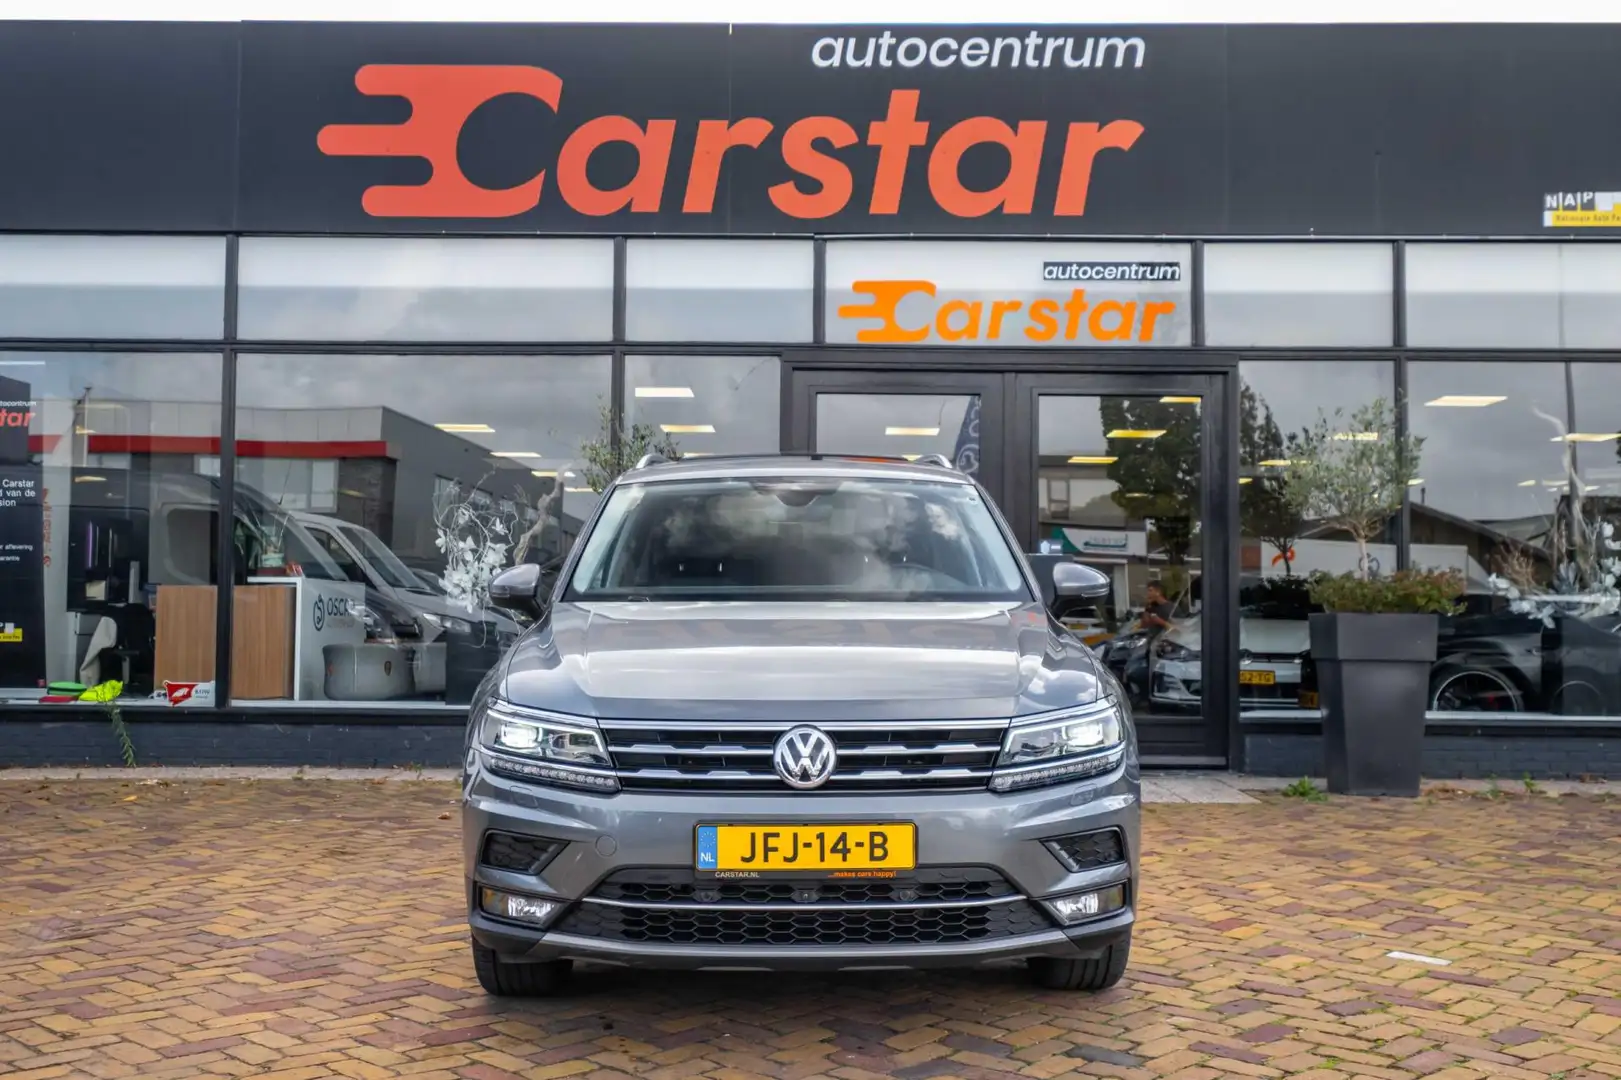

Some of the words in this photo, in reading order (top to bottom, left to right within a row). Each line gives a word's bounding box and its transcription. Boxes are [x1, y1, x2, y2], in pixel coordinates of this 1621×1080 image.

[811, 30, 1146, 68] autocentrum
[316, 63, 1145, 219] Carstar
[1043, 263, 1181, 280] autocentrum
[837, 279, 1176, 343] Carstar
[2, 479, 35, 488] Carstar
[24, 489, 36, 497] de
[700, 852, 715, 863] NL
[740, 831, 889, 863] JFJ-14-B
